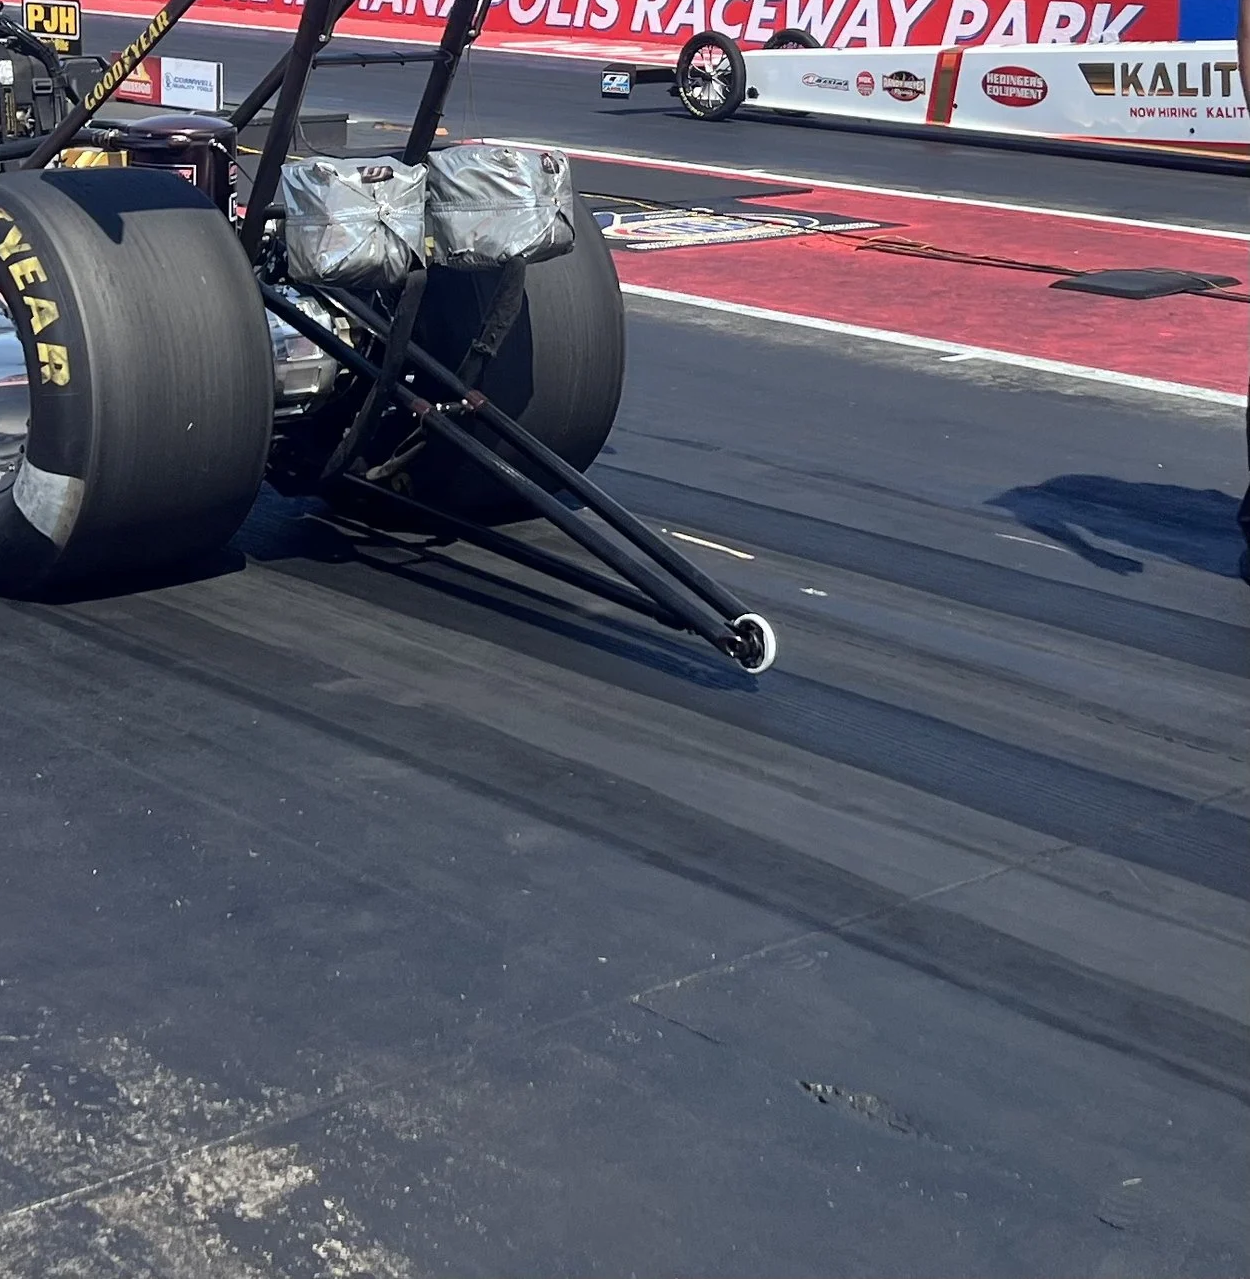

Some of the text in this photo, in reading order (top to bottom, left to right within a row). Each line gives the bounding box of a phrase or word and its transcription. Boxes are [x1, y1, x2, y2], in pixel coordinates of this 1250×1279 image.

[27, 4, 76, 34] PJH
[84, 10, 170, 111] GOODYEAR
[986, 84, 1044, 100] EQUIPMENT
[1130, 107, 1156, 118] NOW
[1158, 107, 1197, 118] HIRING
